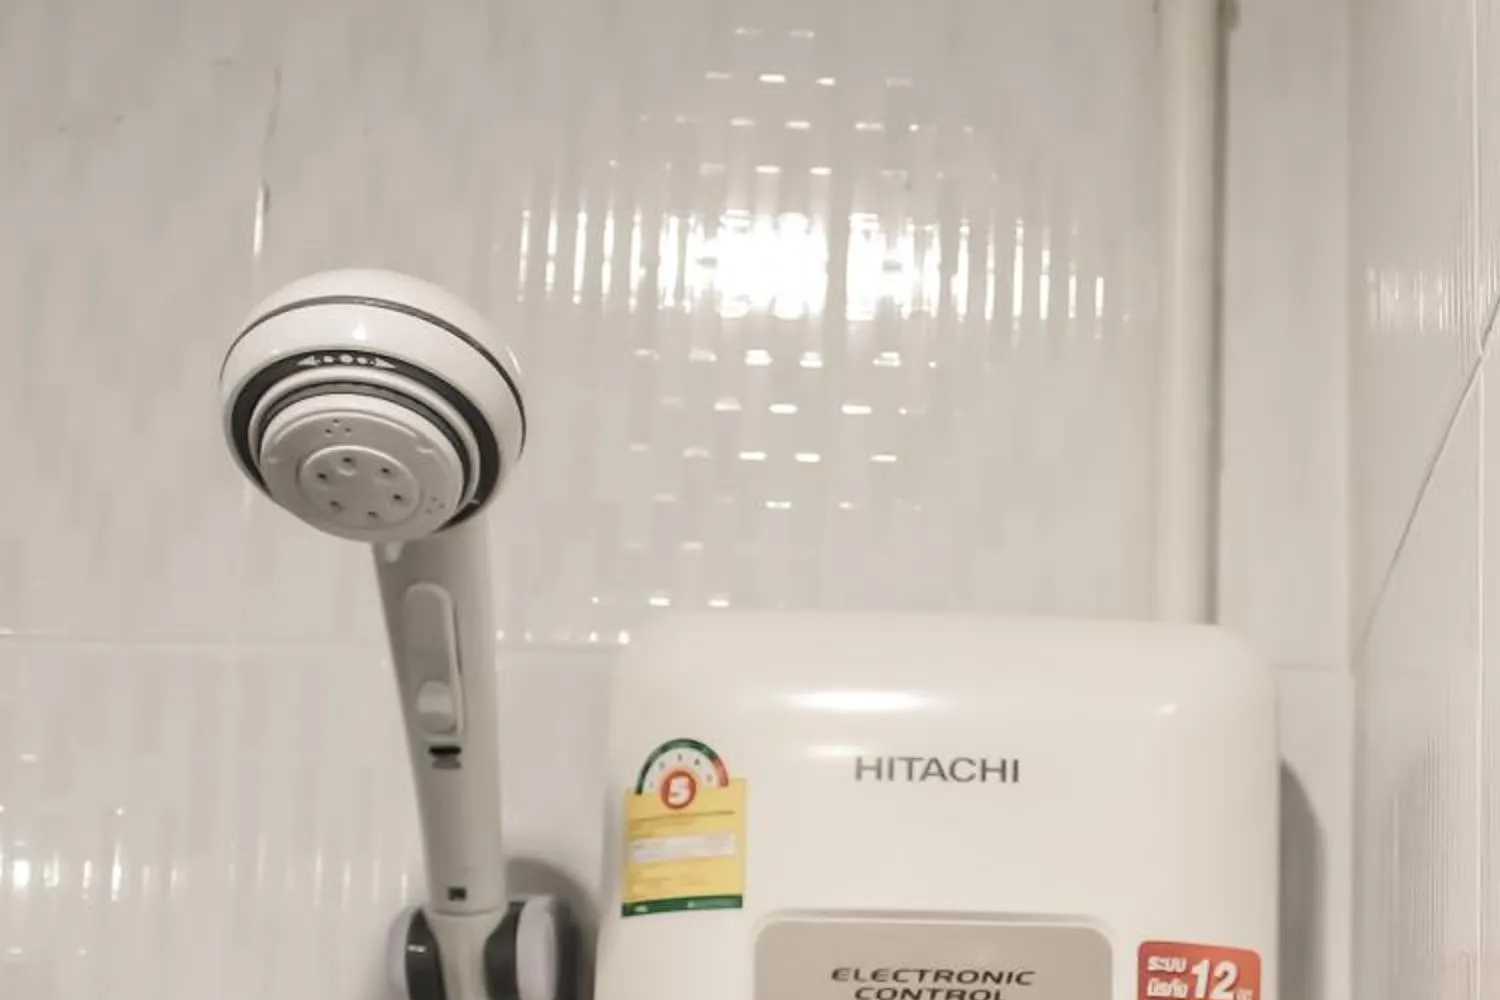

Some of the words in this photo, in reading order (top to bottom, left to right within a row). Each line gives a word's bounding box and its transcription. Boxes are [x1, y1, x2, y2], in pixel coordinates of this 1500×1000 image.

[855, 756, 1019, 783] HITACHI
[668, 775, 692, 806] 5
[831, 967, 1037, 986] ELECTRONIC
